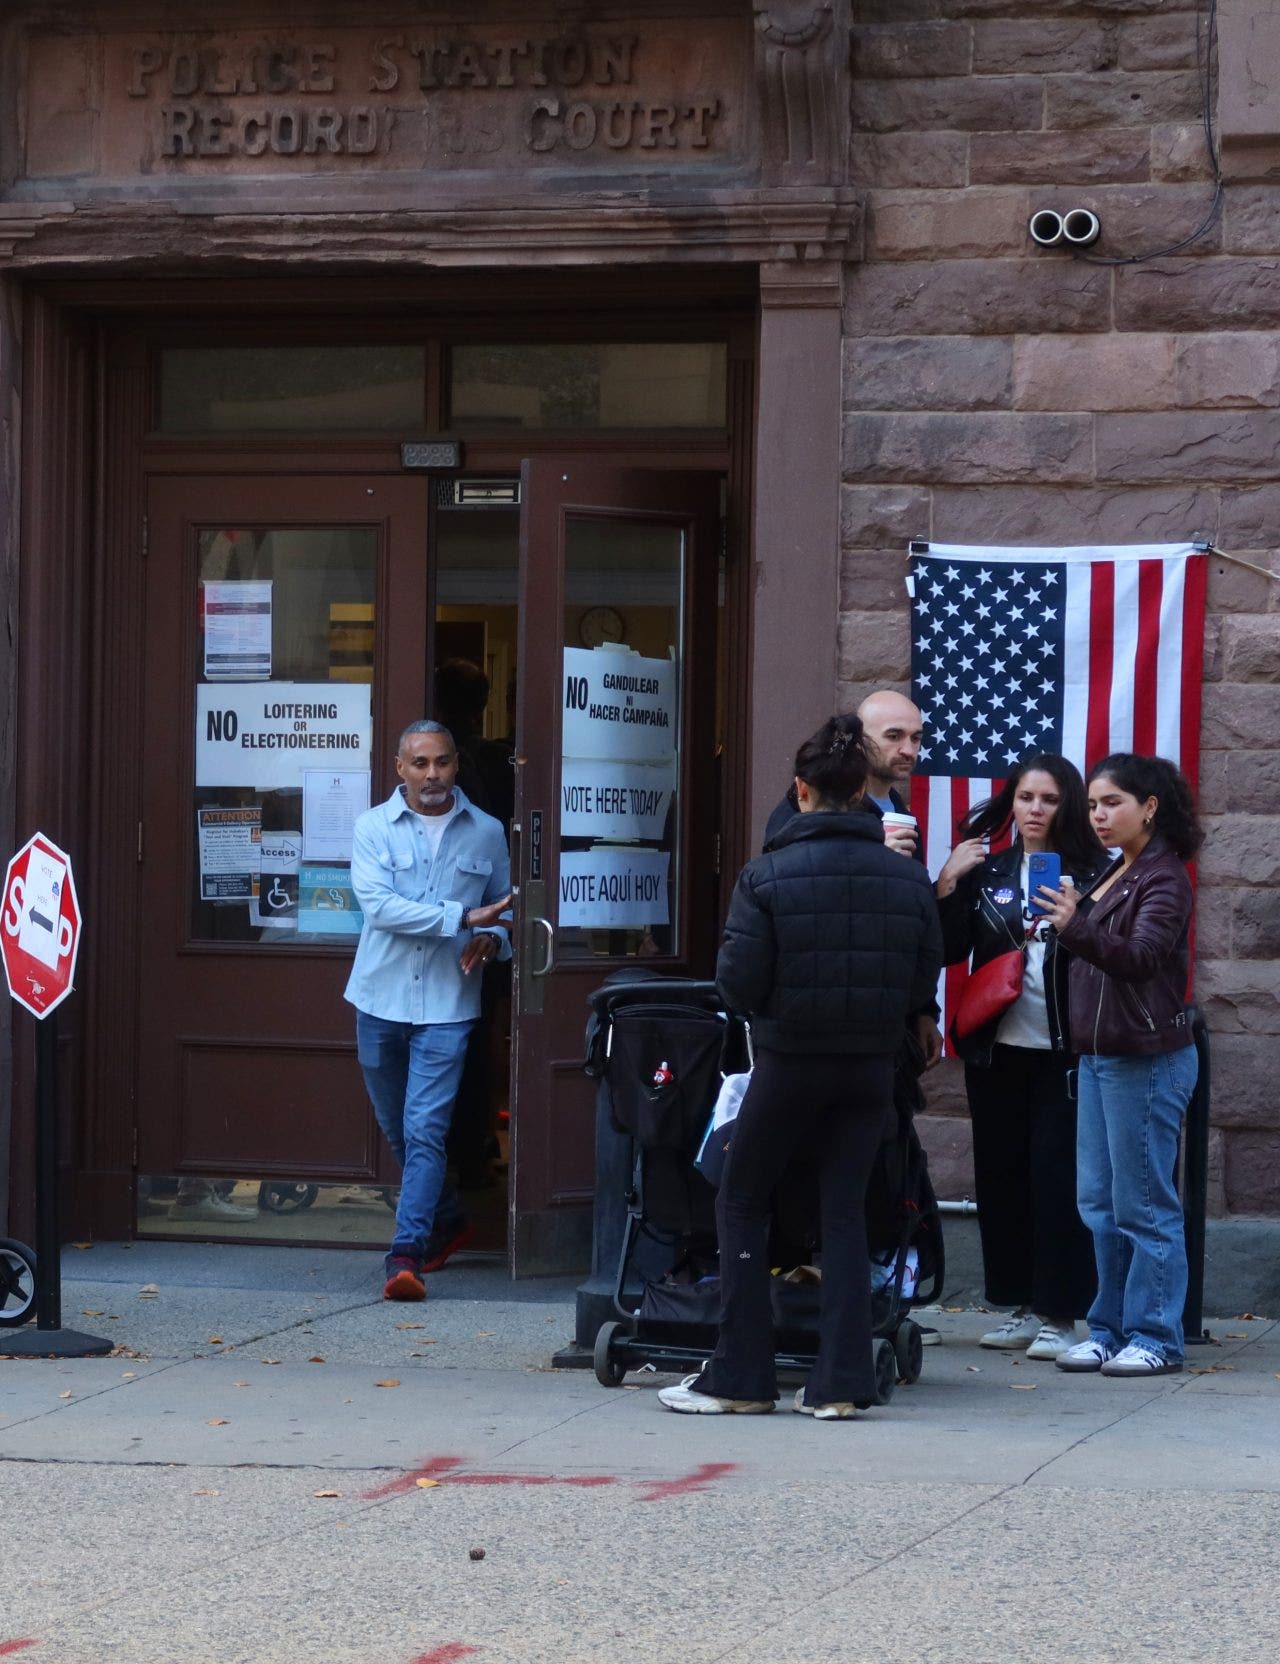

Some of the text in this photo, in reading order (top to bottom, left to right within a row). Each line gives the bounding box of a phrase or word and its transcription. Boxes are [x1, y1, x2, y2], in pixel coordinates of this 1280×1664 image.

[127, 36, 641, 99] POLICE STATION
[523, 98, 720, 154] COURT
[566, 676, 588, 710] NO
[603, 673, 659, 695] GANDULEAR
[264, 703, 338, 719] LOITERING
[626, 695, 634, 706] NI
[206, 710, 238, 742] NO
[293, 721, 307, 732] OR
[589, 703, 669, 728] HACER CAMPAÑA
[241, 733, 360, 749] ELECTIONEERING
[563, 786, 663, 816] VOTE HERE TODAY
[204, 811, 260, 823] ATTENTION
[261, 848, 296, 857] Access
[561, 868, 660, 903] VOTE AQUÍ HOY
[5, 876, 73, 957] SP
